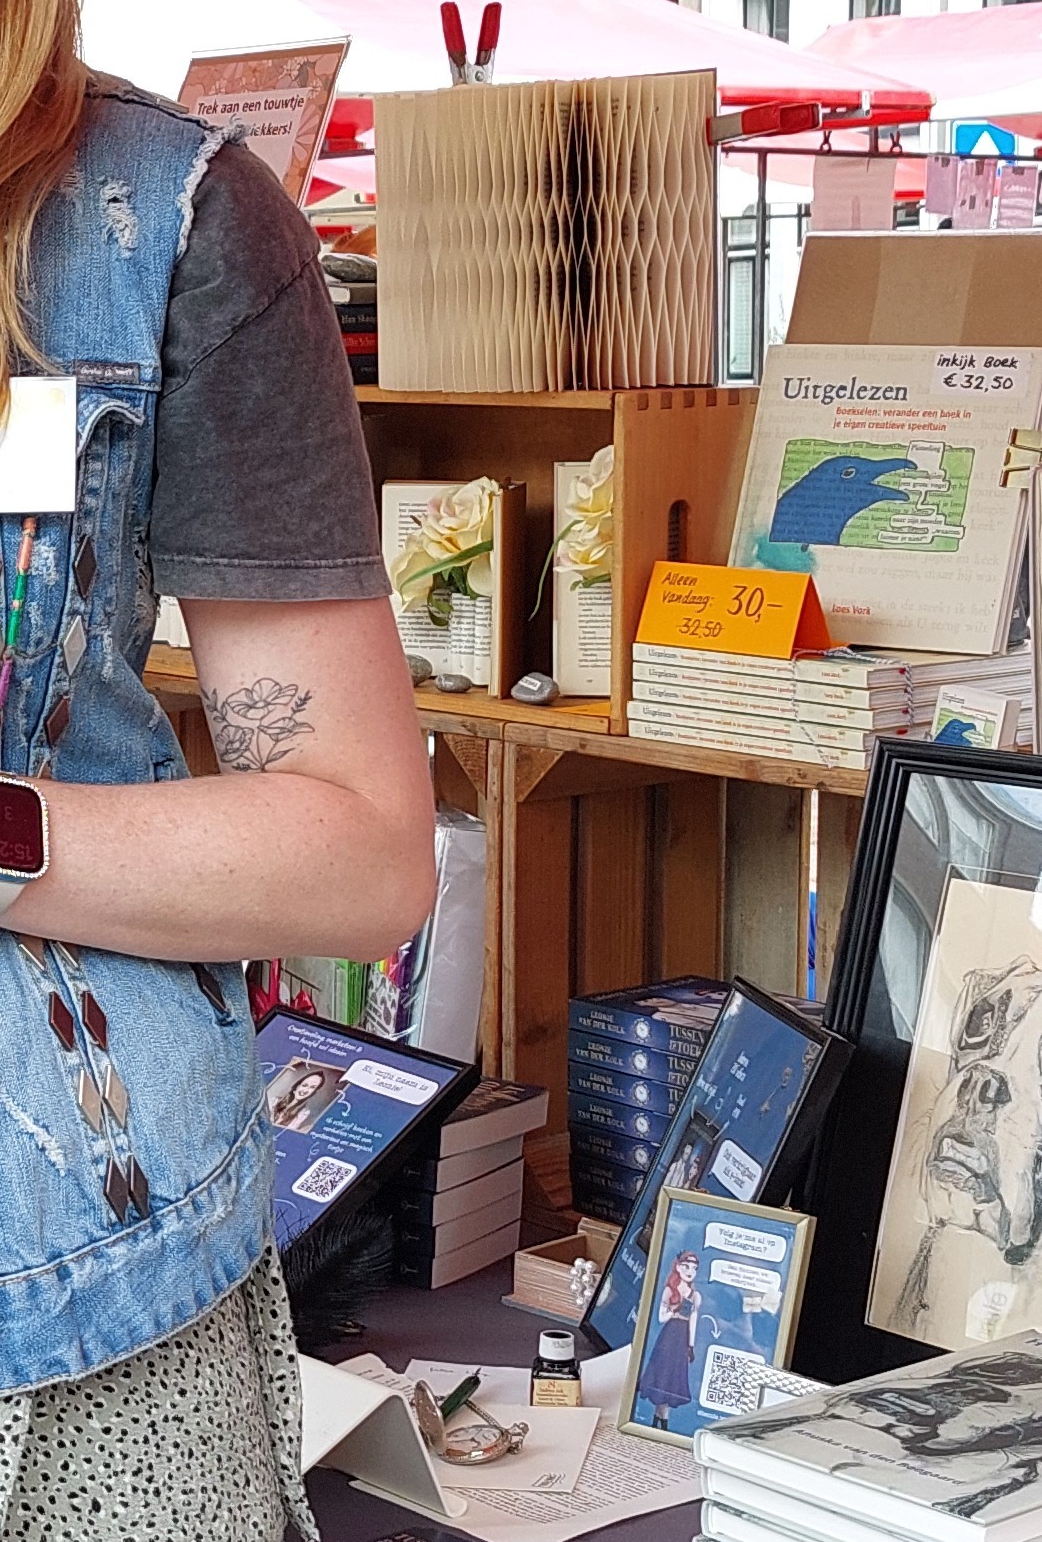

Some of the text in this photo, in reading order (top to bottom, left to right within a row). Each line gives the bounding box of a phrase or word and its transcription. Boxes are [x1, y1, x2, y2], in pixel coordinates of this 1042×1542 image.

[197, 94, 305, 116] Trek aan een touwtje
[983, 354, 1019, 370] Boek
[783, 375, 908, 405] Uitgelezen
[883, 408, 920, 417] verander
[922, 409, 937, 418] een
[940, 409, 961, 419] boek
[963, 409, 972, 419] in
[833, 419, 947, 432] je eigen creatieve speeltuin
[661, 571, 699, 587] Alleen
[831, 603, 851, 615] Loes
[724, 1238, 768, 1254] Instagram?
[791, 1428, 842, 1447] Anuska
[842, 1444, 869, 1456] van
[868, 1452, 898, 1464] den
